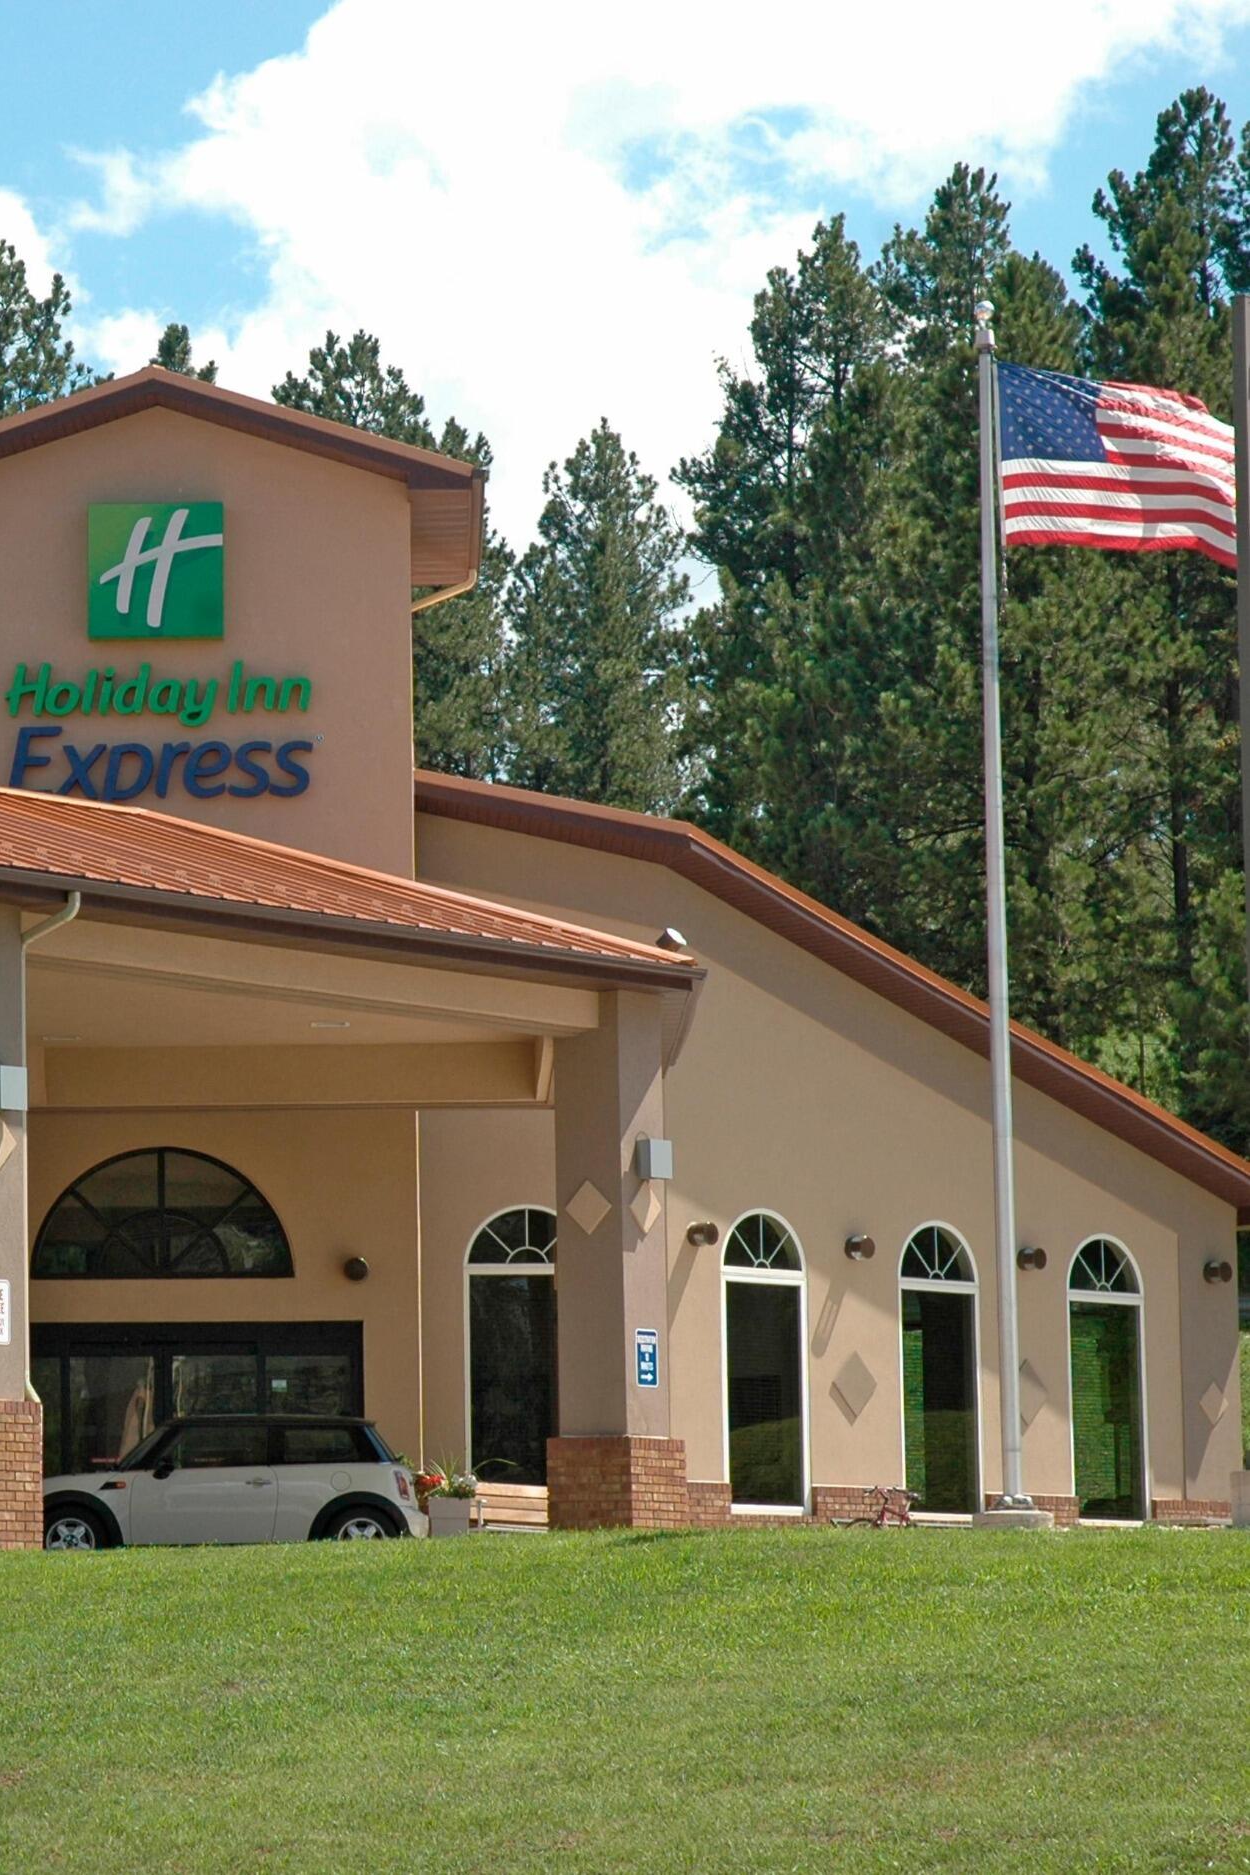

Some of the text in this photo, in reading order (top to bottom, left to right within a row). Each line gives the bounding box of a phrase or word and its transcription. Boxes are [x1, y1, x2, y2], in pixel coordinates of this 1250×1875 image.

[5, 660, 312, 727] Holiday Inn
[8, 726, 314, 801] Express
